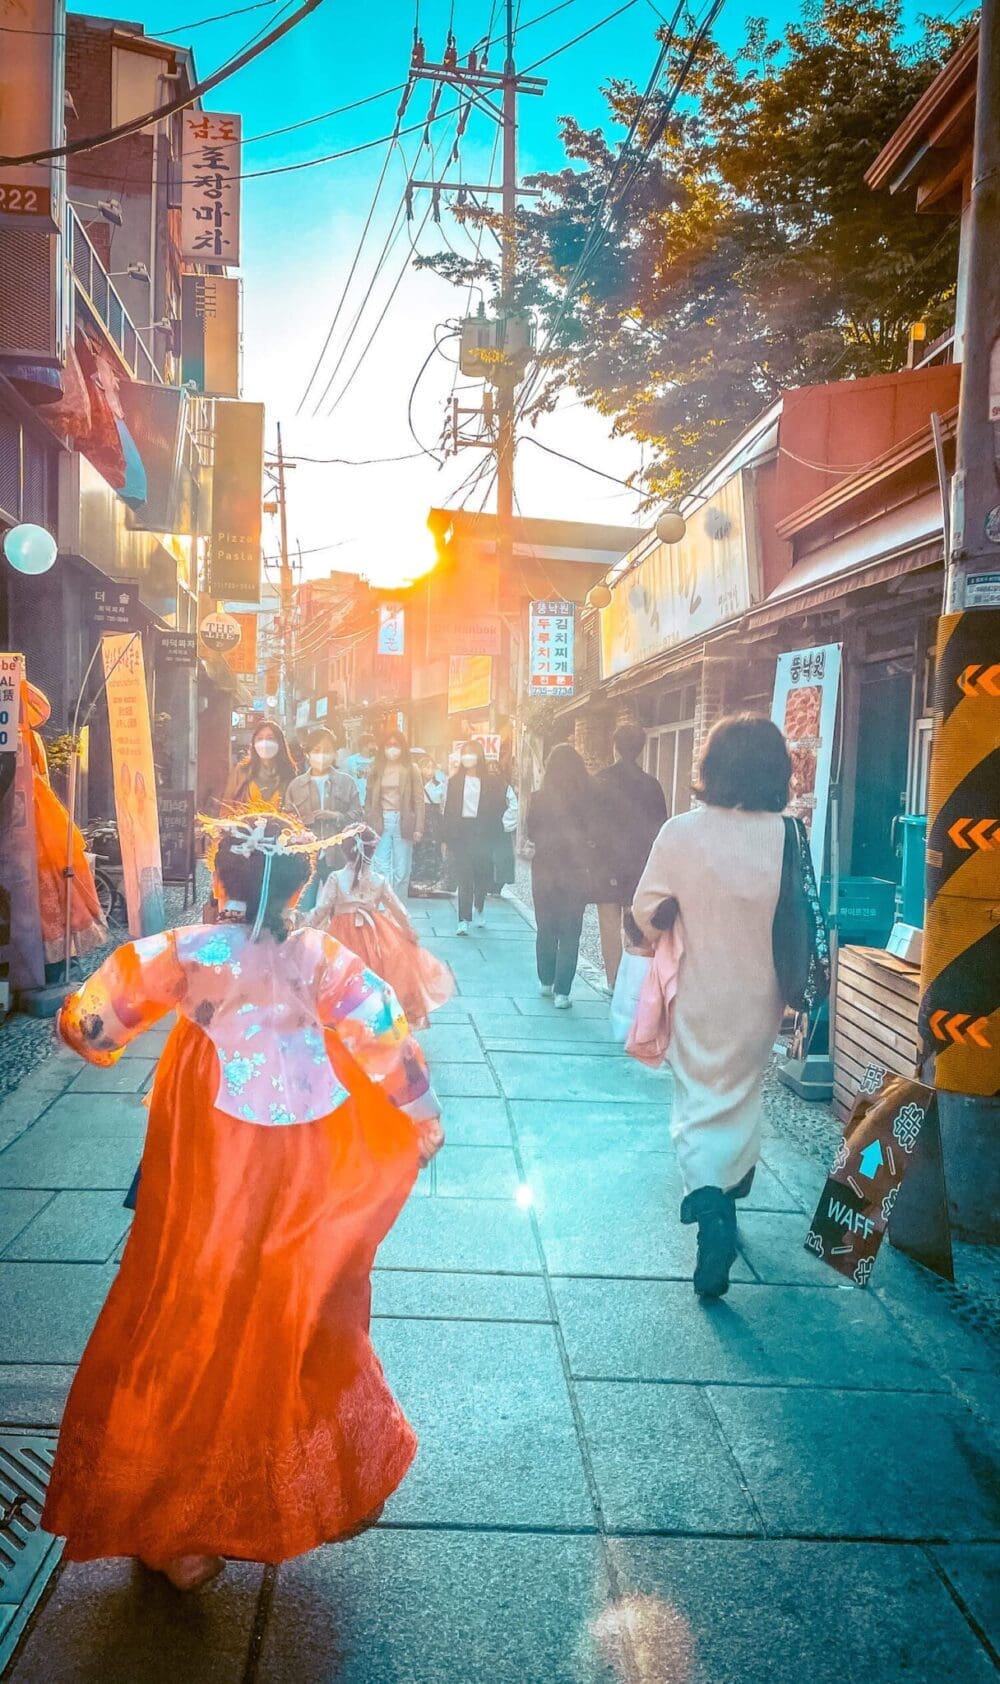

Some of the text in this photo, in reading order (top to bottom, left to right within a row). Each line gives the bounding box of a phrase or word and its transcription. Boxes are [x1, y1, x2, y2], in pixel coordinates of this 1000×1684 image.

[186, 116, 238, 142] 남도
[192, 145, 232, 256] 포장마차
[217, 550, 253, 561] Pasta
[554, 618, 568, 673] 김치찌개
[827, 1197, 875, 1239] WAFF
